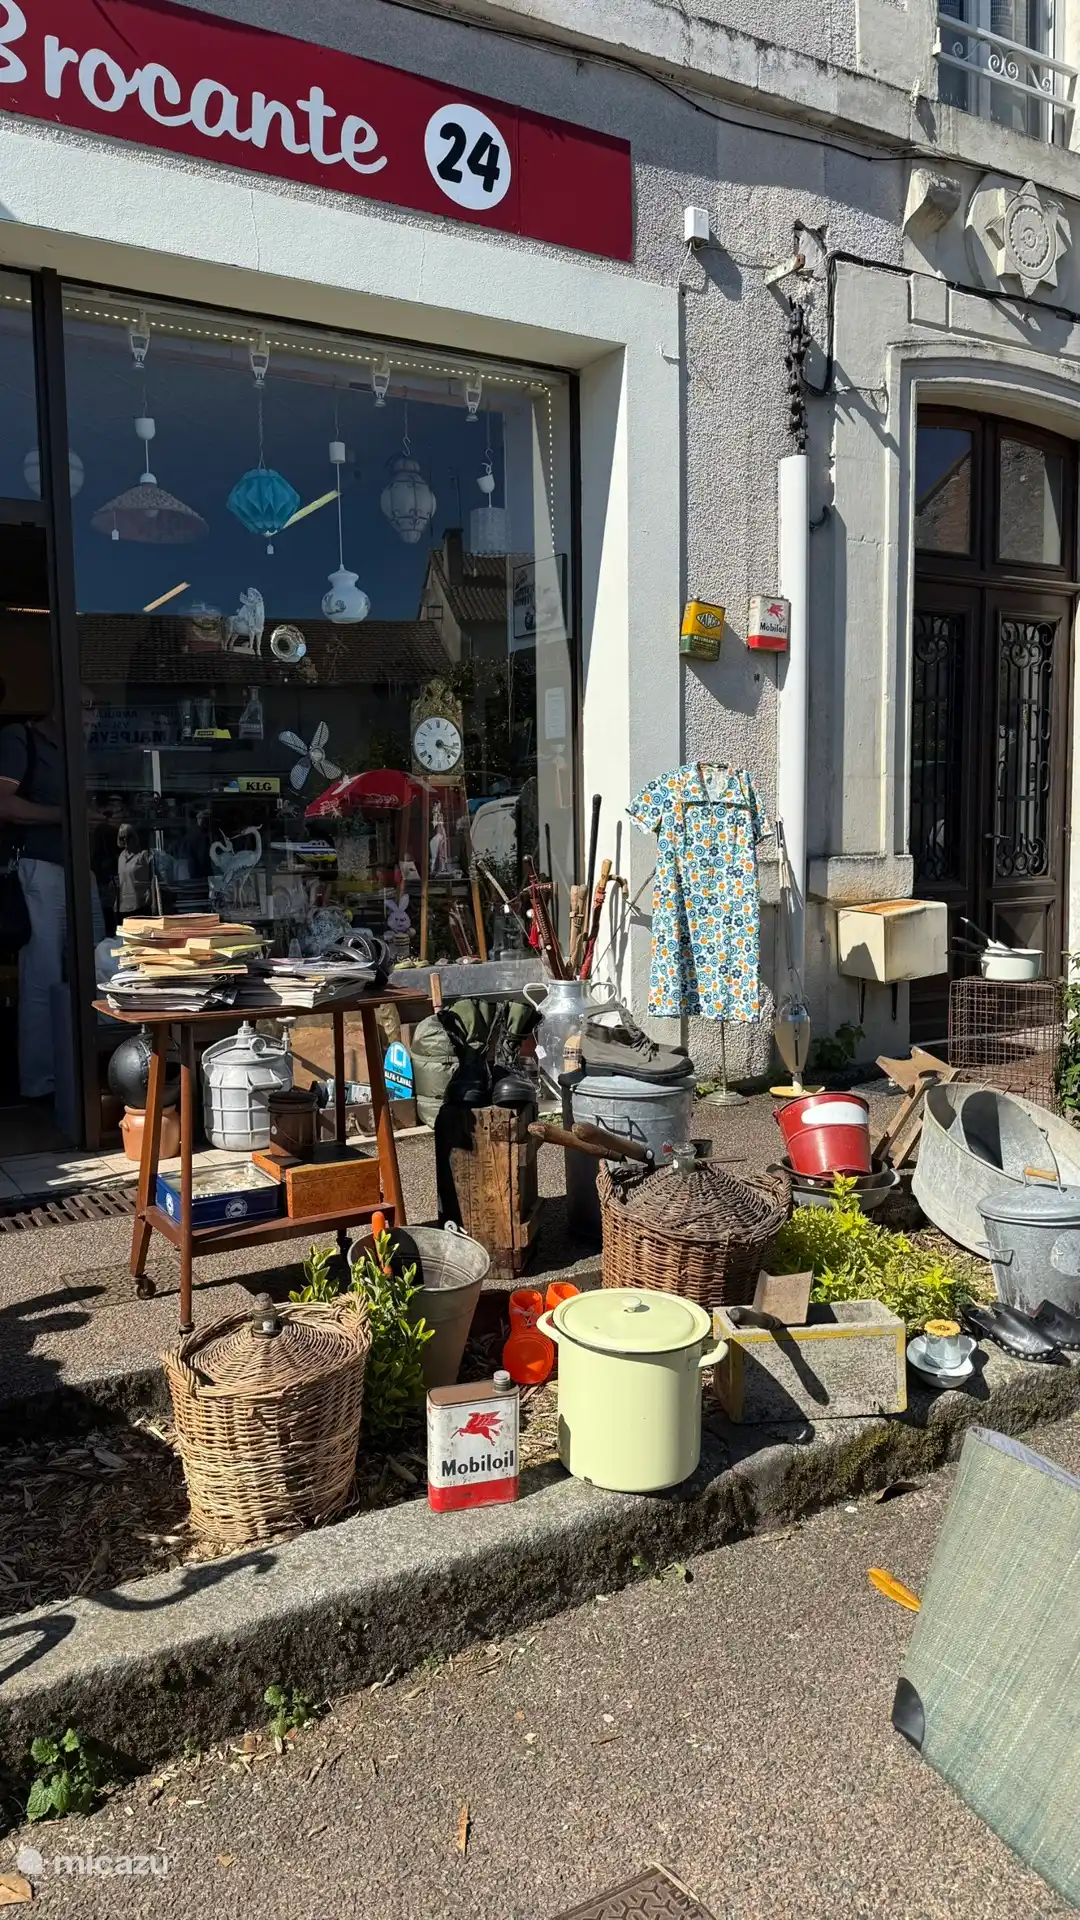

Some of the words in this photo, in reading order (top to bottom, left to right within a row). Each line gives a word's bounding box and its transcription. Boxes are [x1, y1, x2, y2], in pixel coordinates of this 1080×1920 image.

[436, 121, 501, 192] 24
[760, 621, 787, 634] Mobiloil
[246, 782, 272, 791] KLG
[442, 1450, 514, 1477] Mobiloil
